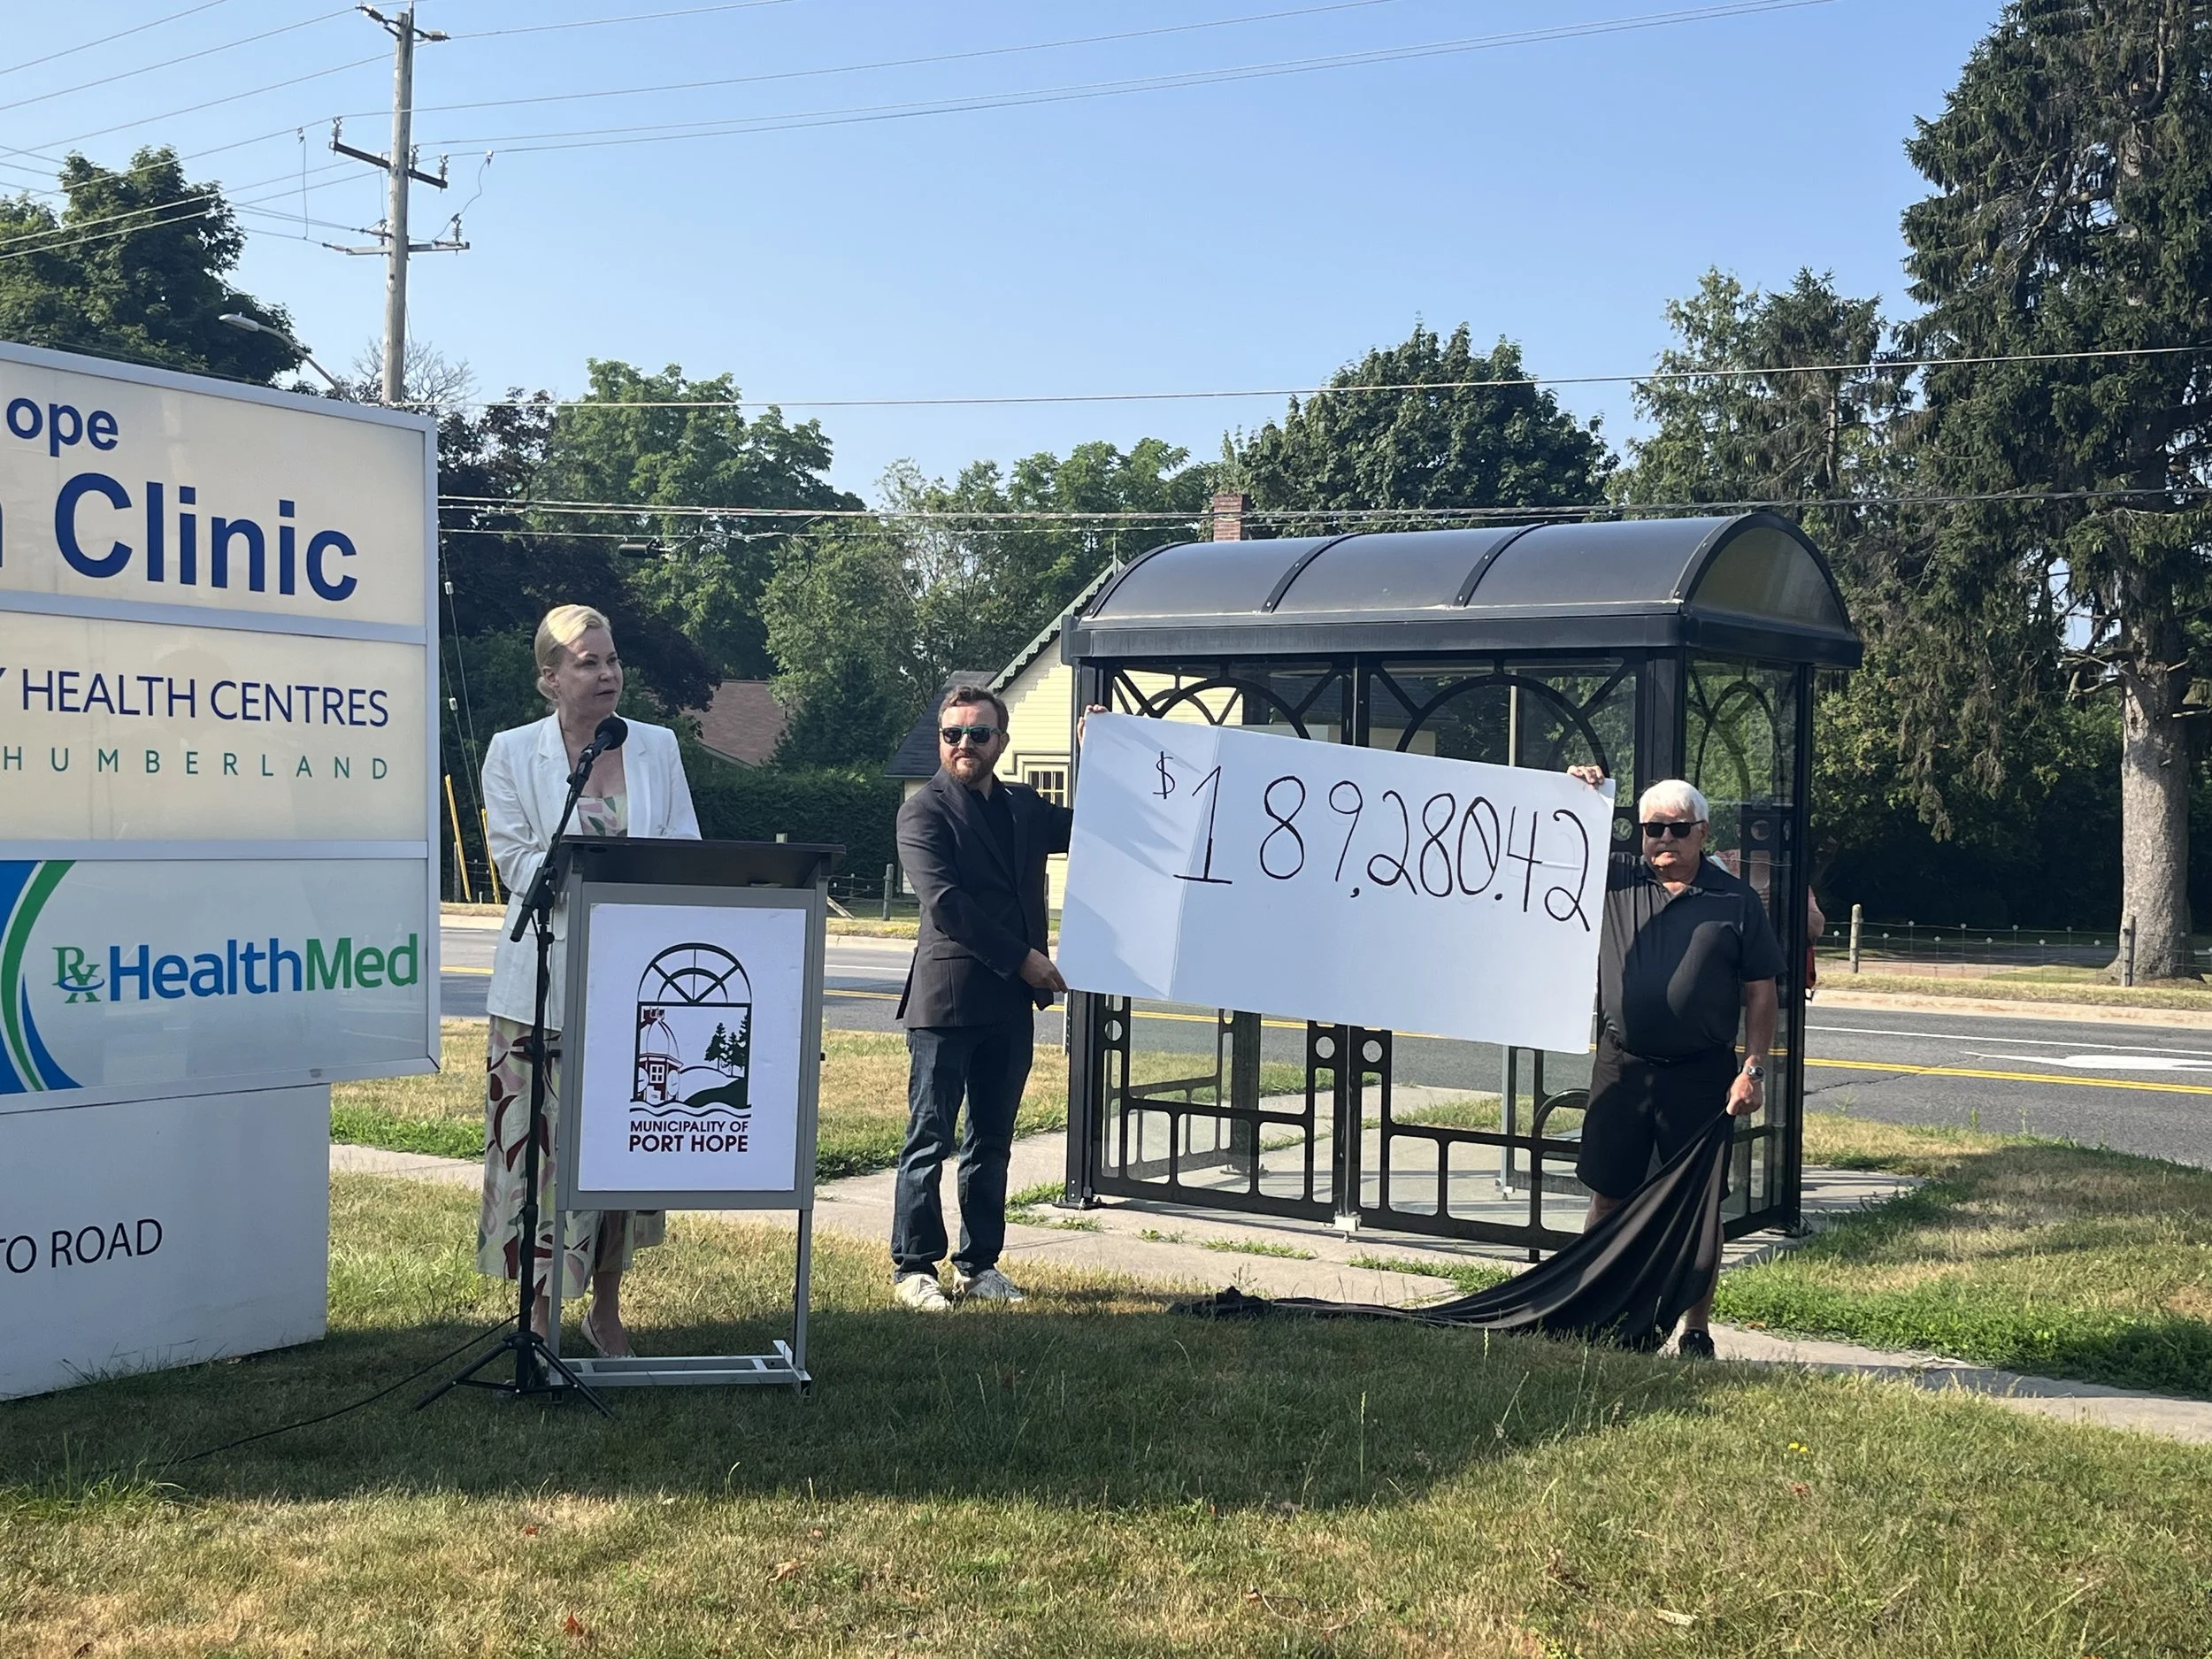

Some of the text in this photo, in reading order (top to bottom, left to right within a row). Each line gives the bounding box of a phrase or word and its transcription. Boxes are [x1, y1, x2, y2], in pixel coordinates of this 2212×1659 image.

[54, 472, 358, 602] Clinic
[22, 668, 388, 727] HEALTH CENTRES
[4, 746, 388, 779] HUMBERLAND
[109, 933, 418, 1002] HealthMed
[629, 1134, 749, 1153] PORT HOPE
[630, 1120, 749, 1133] MUNICIPALITY OF
[51, 1218, 163, 1268] ROAD
